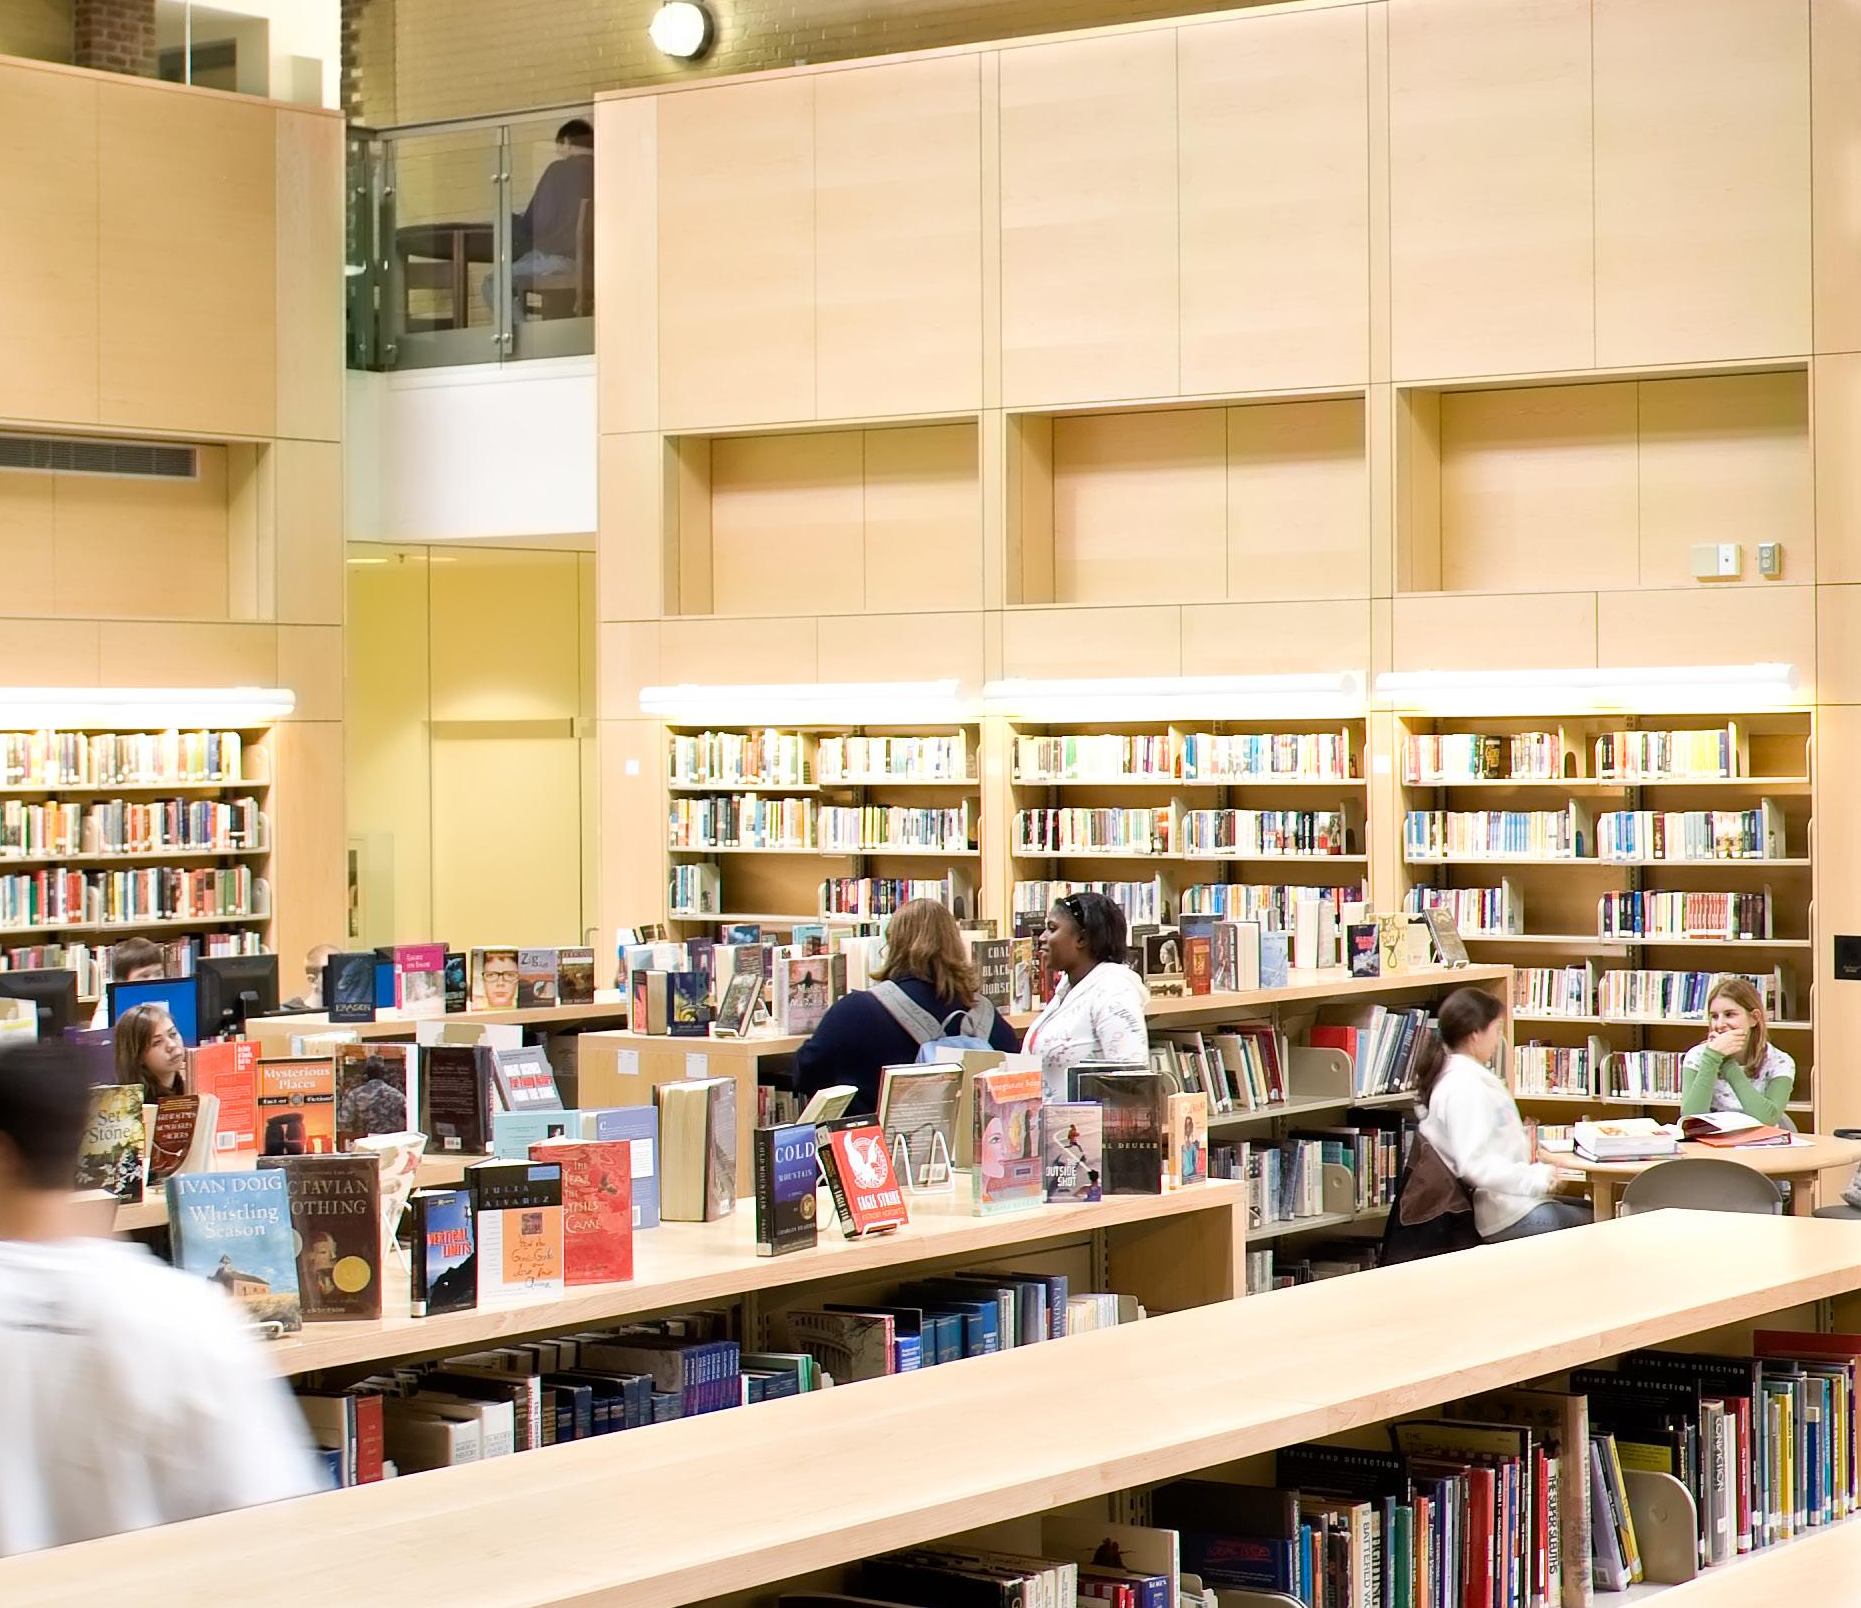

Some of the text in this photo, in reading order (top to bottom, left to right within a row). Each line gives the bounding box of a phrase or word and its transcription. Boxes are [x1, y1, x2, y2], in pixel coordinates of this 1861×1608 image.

[988, 946, 1010, 958] COAL
[982, 964, 1011, 977] BLACK
[265, 1067, 330, 1082] Mysterious
[278, 1079, 316, 1090] Places
[98, 1109, 121, 1127] Set
[89, 1125, 132, 1143] Stone
[775, 1141, 816, 1164] COLD
[778, 1168, 813, 1183] MOUNTAIN
[1045, 1166, 1076, 1178] OUTSIDE
[179, 1175, 283, 1195] IVAN DOIG
[1057, 1176, 1077, 1187] SHOT
[857, 1190, 902, 1212] EAGLE STRIKE
[189, 1204, 281, 1224] Whistling
[204, 1222, 267, 1240] Season
[427, 1227, 469, 1247] VERTICAL
[440, 1243, 472, 1259] LIMITS
[1714, 1415, 1726, 1493] CONVICTION
[1363, 1521, 1372, 1589] BATTERED
